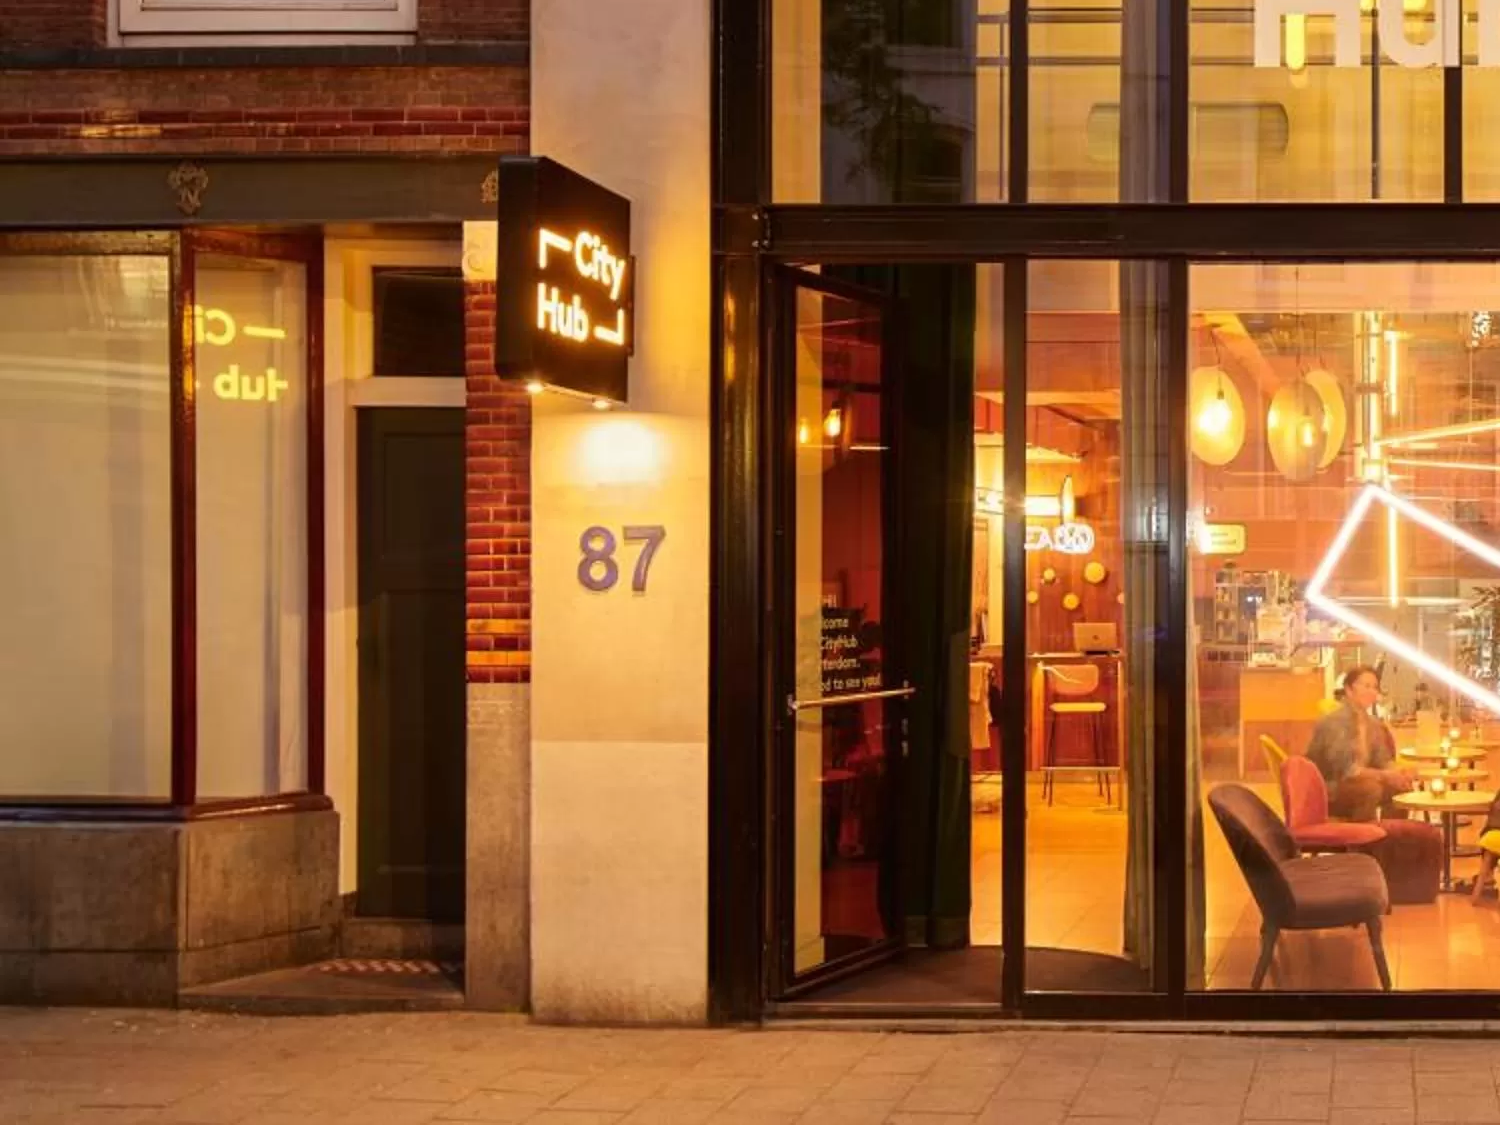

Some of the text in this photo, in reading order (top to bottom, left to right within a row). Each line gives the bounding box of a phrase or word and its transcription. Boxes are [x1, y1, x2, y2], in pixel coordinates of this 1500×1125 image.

[575, 231, 626, 301] City
[537, 281, 589, 343] Hub
[577, 525, 667, 593] 87
